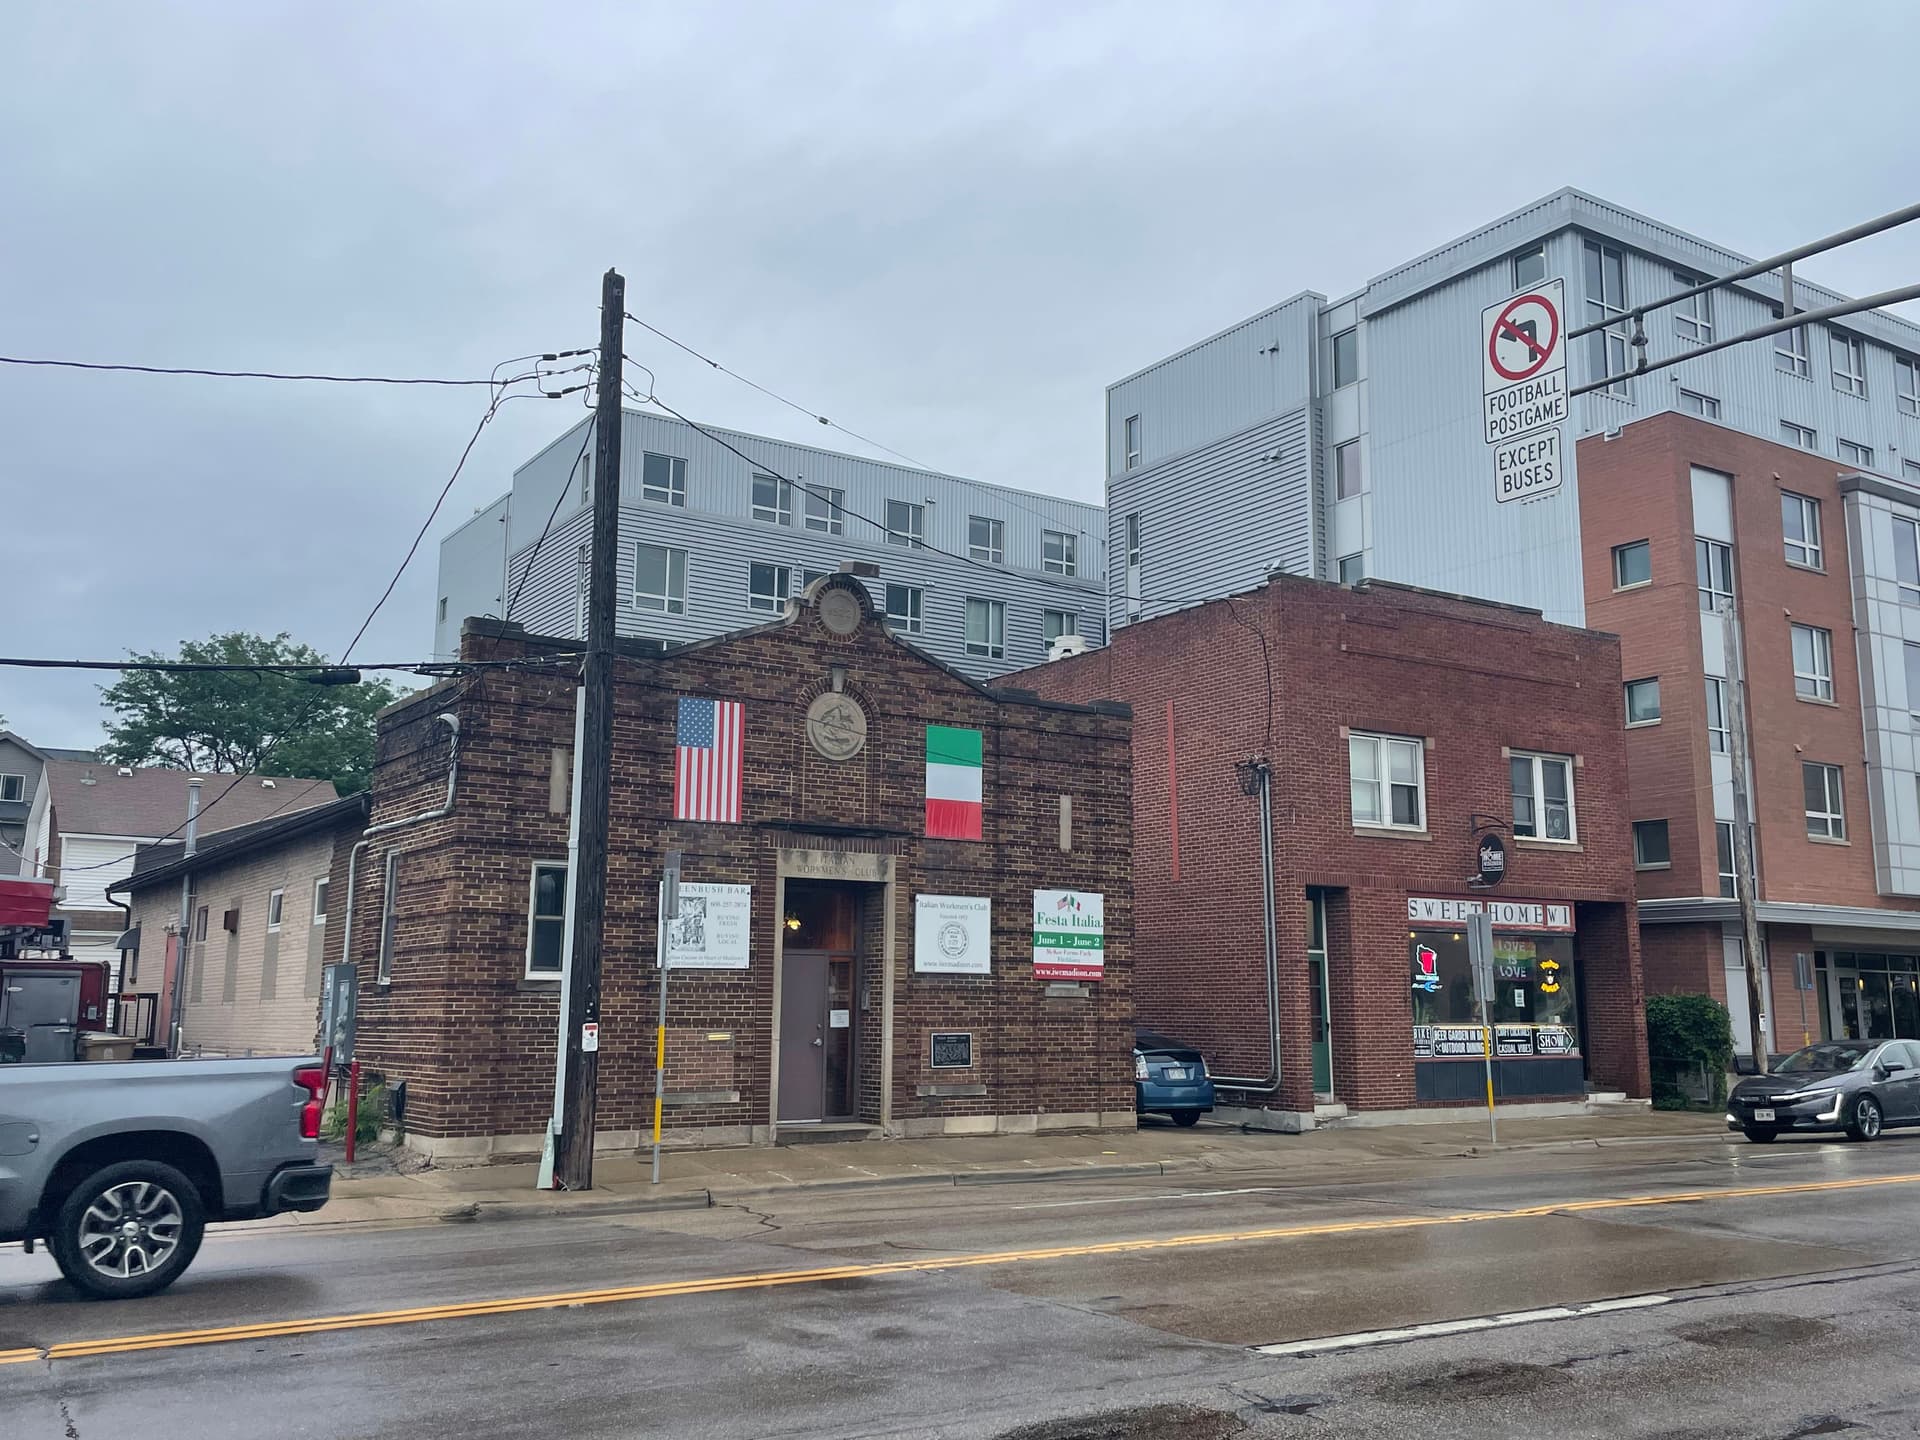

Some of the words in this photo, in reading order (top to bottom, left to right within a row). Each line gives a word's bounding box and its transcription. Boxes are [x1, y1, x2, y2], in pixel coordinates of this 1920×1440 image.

[1490, 376, 1560, 415] FOOTBALL
[1490, 398, 1563, 438] POSTGAME
[1499, 437, 1555, 471] EXCEPT
[1503, 462, 1553, 494] BUSES
[817, 854, 855, 865] ITALIAN
[680, 885, 723, 894] EENBUSH
[727, 886, 746, 895] BAR
[939, 902, 973, 910] Workmen's
[974, 903, 988, 911] Club
[1409, 899, 1482, 921] SWEET
[1487, 904, 1543, 925] HOME
[1547, 906, 1569, 925] WI
[1037, 911, 1068, 927] Festa
[1072, 913, 1101, 928] Italia
[1037, 934, 1057, 945] June
[1059, 935, 1064, 945] 1
[1073, 936, 1092, 947] June
[1094, 937, 1100, 947] 2
[1498, 940, 1527, 952] LOVE
[1508, 955, 1518, 965] IS
[1035, 967, 1102, 977] www.iwcmadison.com
[1499, 965, 1527, 978] LOVE
[1413, 1028, 1430, 1039] BIKE
[1434, 1030, 1447, 1040] BEER
[1447, 1030, 1469, 1041] GARDEN
[1540, 1034, 1564, 1047] SHOW
[1441, 1042, 1466, 1053] OUTDOOR
[1498, 1043, 1517, 1053] CASUAL
[1517, 1043, 1532, 1053] VIBES
